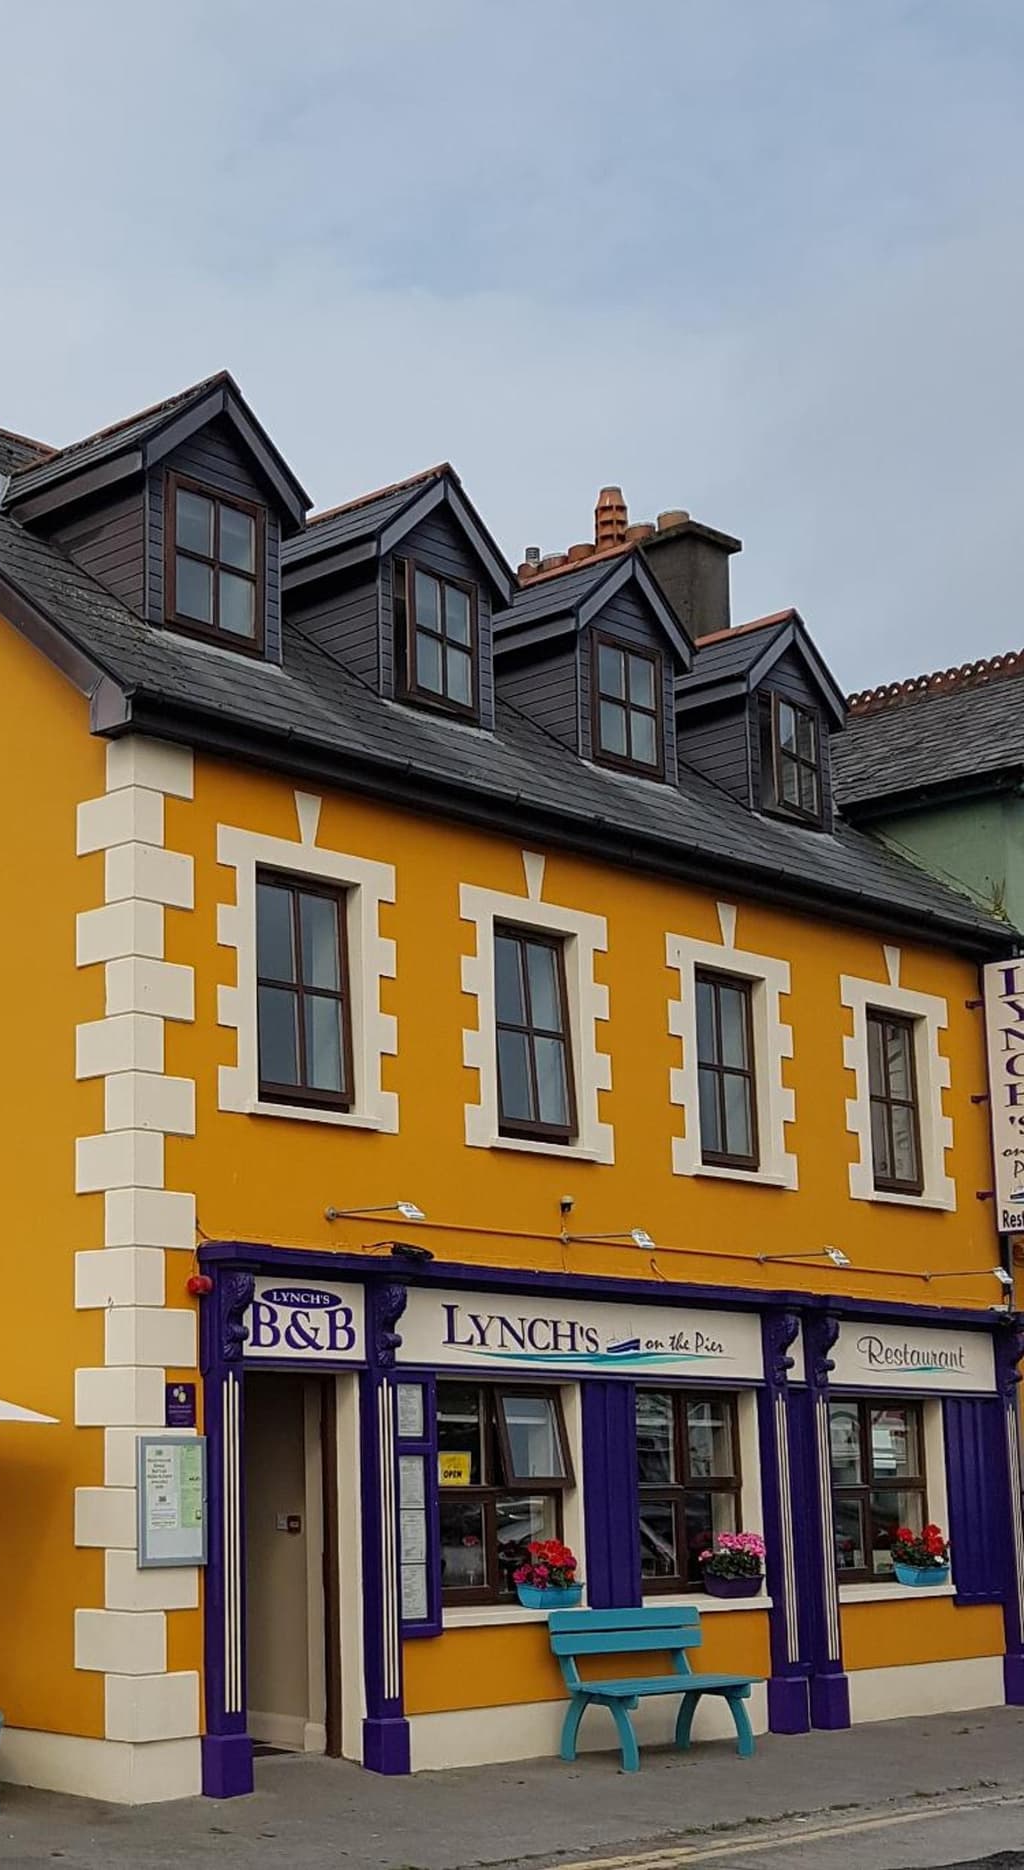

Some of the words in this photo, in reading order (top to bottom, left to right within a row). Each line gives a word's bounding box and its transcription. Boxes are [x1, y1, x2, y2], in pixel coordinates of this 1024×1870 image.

[272, 1291, 330, 1305] LYNCH'S
[249, 1301, 356, 1351] B&B
[441, 1303, 600, 1354] LYNCH'S
[644, 1340, 665, 1350] on
[669, 1331, 689, 1351] the
[695, 1331, 723, 1353] Pier
[856, 1335, 965, 1369] Restaurant
[443, 1470, 463, 1479] OPEN
